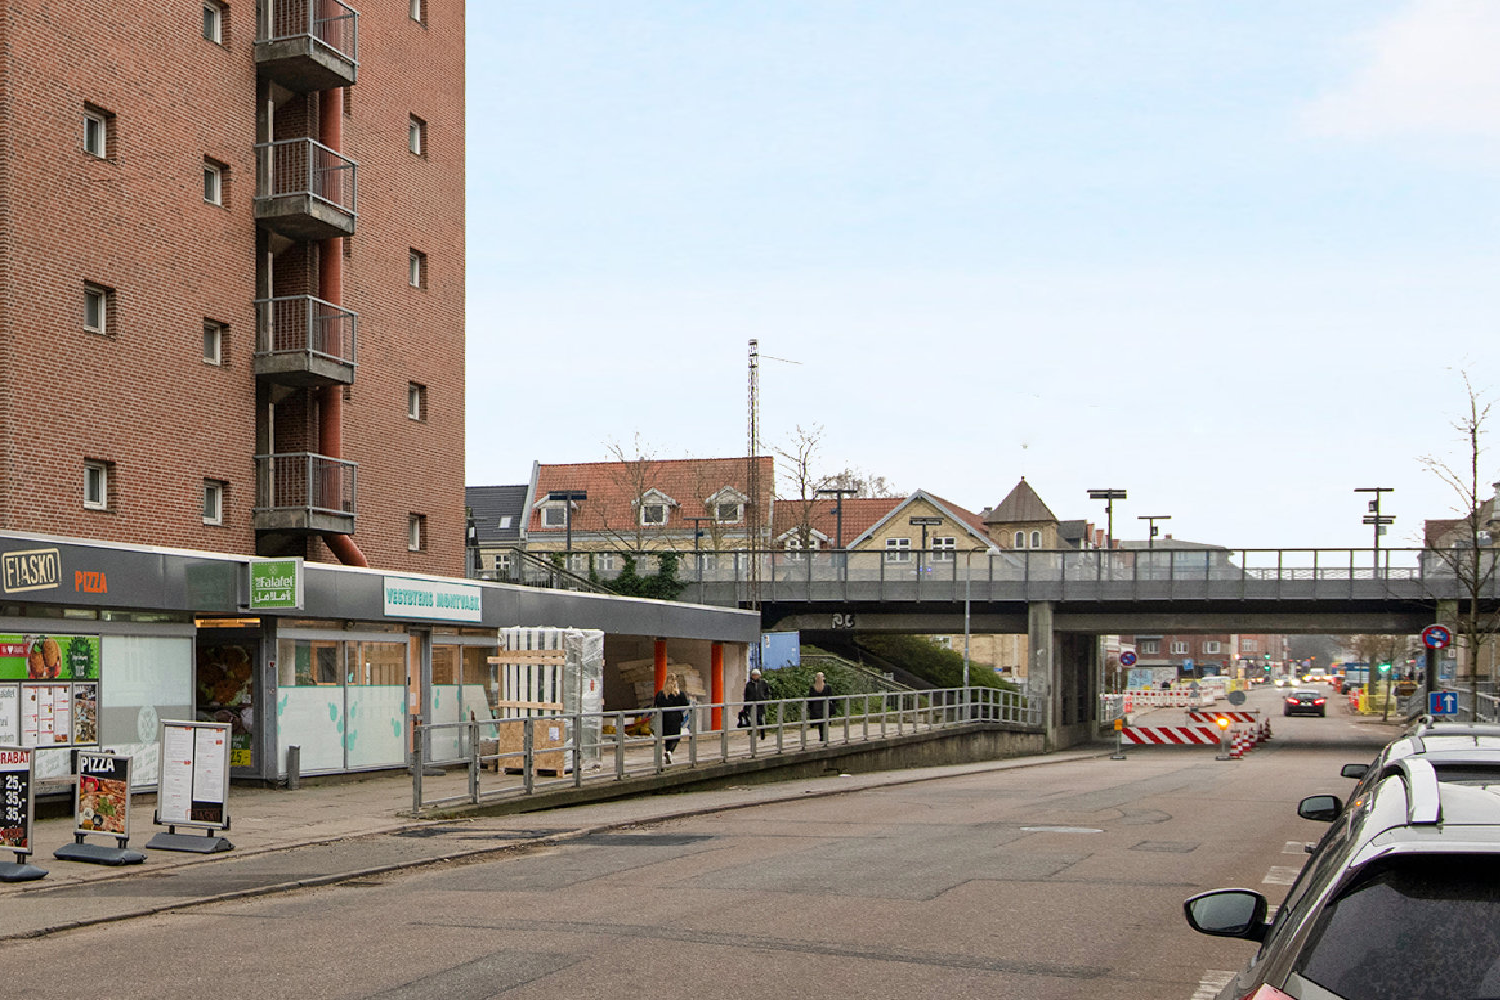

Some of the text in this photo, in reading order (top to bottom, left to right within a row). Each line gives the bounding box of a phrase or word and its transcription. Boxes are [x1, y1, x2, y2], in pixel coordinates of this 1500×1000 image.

[6, 554, 56, 587] FIASKO
[75, 570, 108, 594] PIZZA
[80, 756, 116, 773] PIZZA
